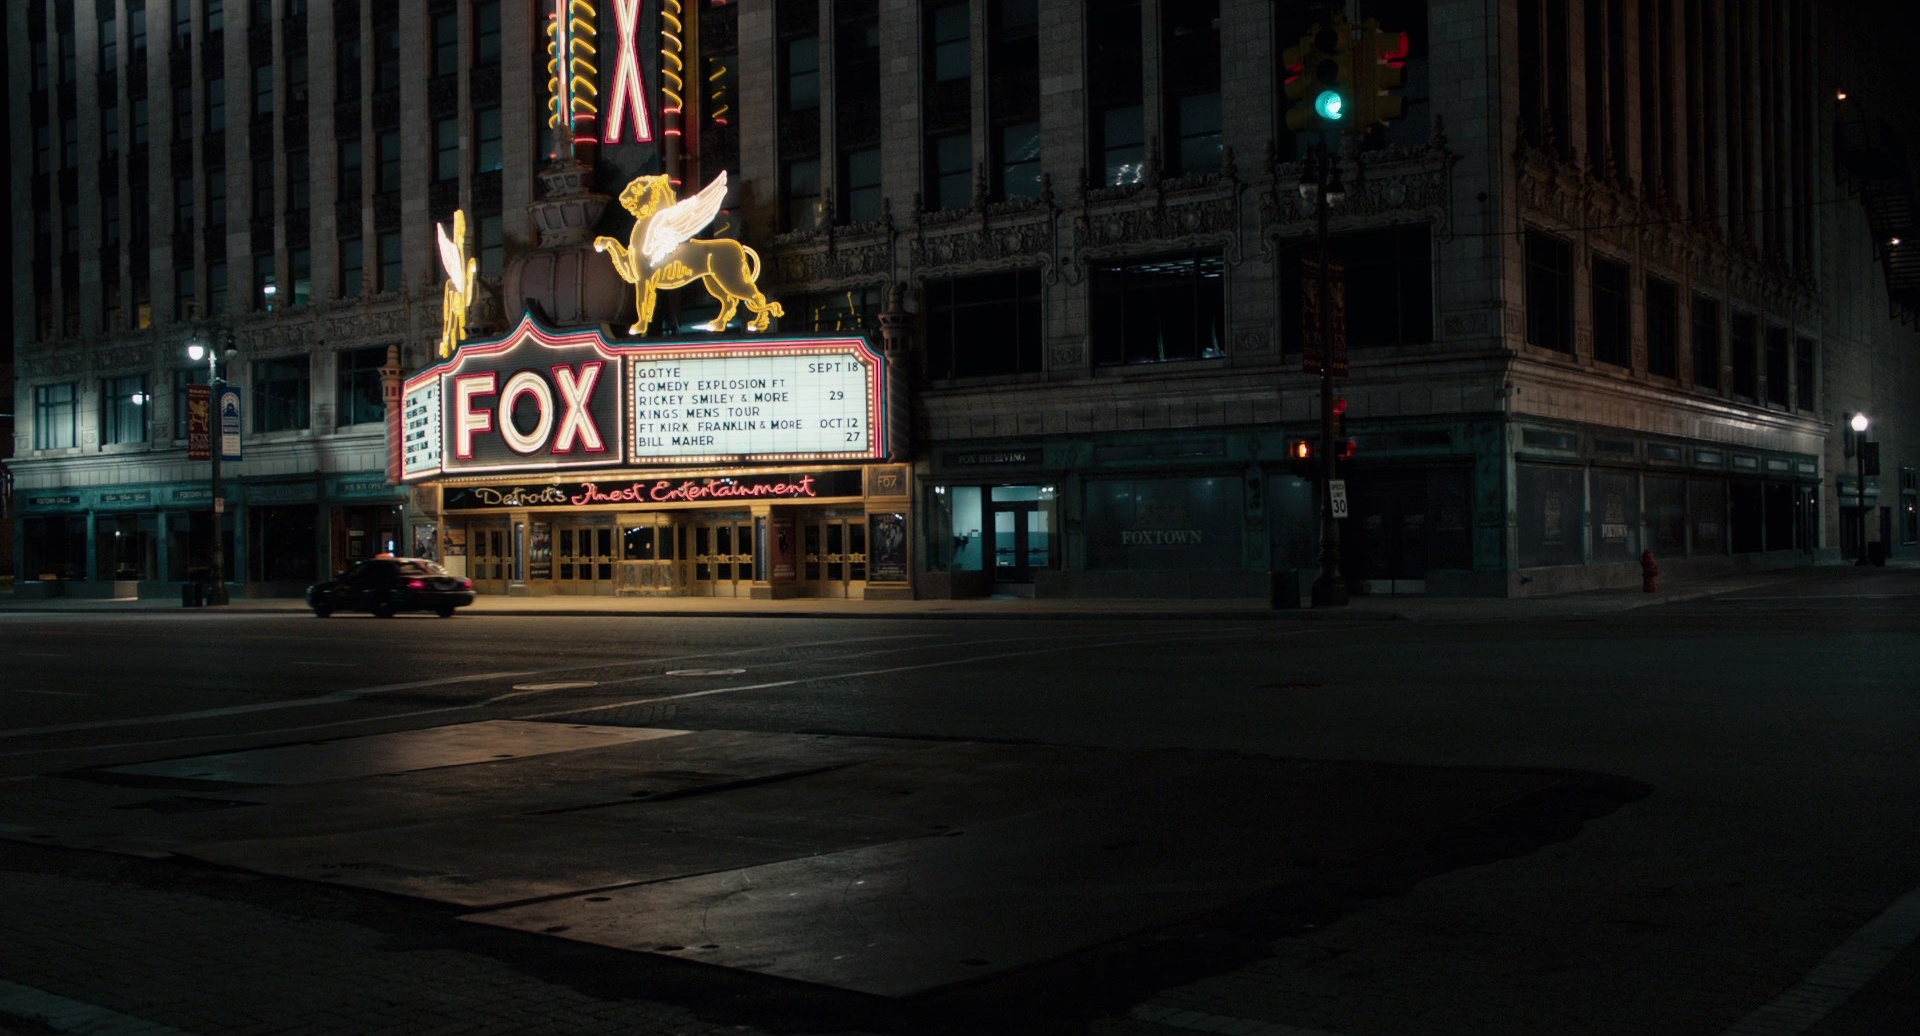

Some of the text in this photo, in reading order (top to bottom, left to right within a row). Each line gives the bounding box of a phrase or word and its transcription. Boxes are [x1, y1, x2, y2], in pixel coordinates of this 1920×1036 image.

[638, 362, 859, 379] GOTYE SEPT 18
[638, 379, 785, 392] COMEDY EXPLOSION FT
[639, 390, 844, 406] RICKEY SMILEY & MORE 29
[455, 361, 605, 461] FOX
[639, 406, 760, 419] KINGS MENS TOUR
[640, 418, 858, 433] FT KIRK FRANKLIN & MORE OCT 12
[638, 431, 861, 447] BILL MAHER 27
[878, 475, 897, 488] FOX
[475, 474, 816, 506] Detroit's Finest Entertainment
[1333, 499, 1346, 513] 30
[1121, 529, 1203, 545] FOXTOWN
